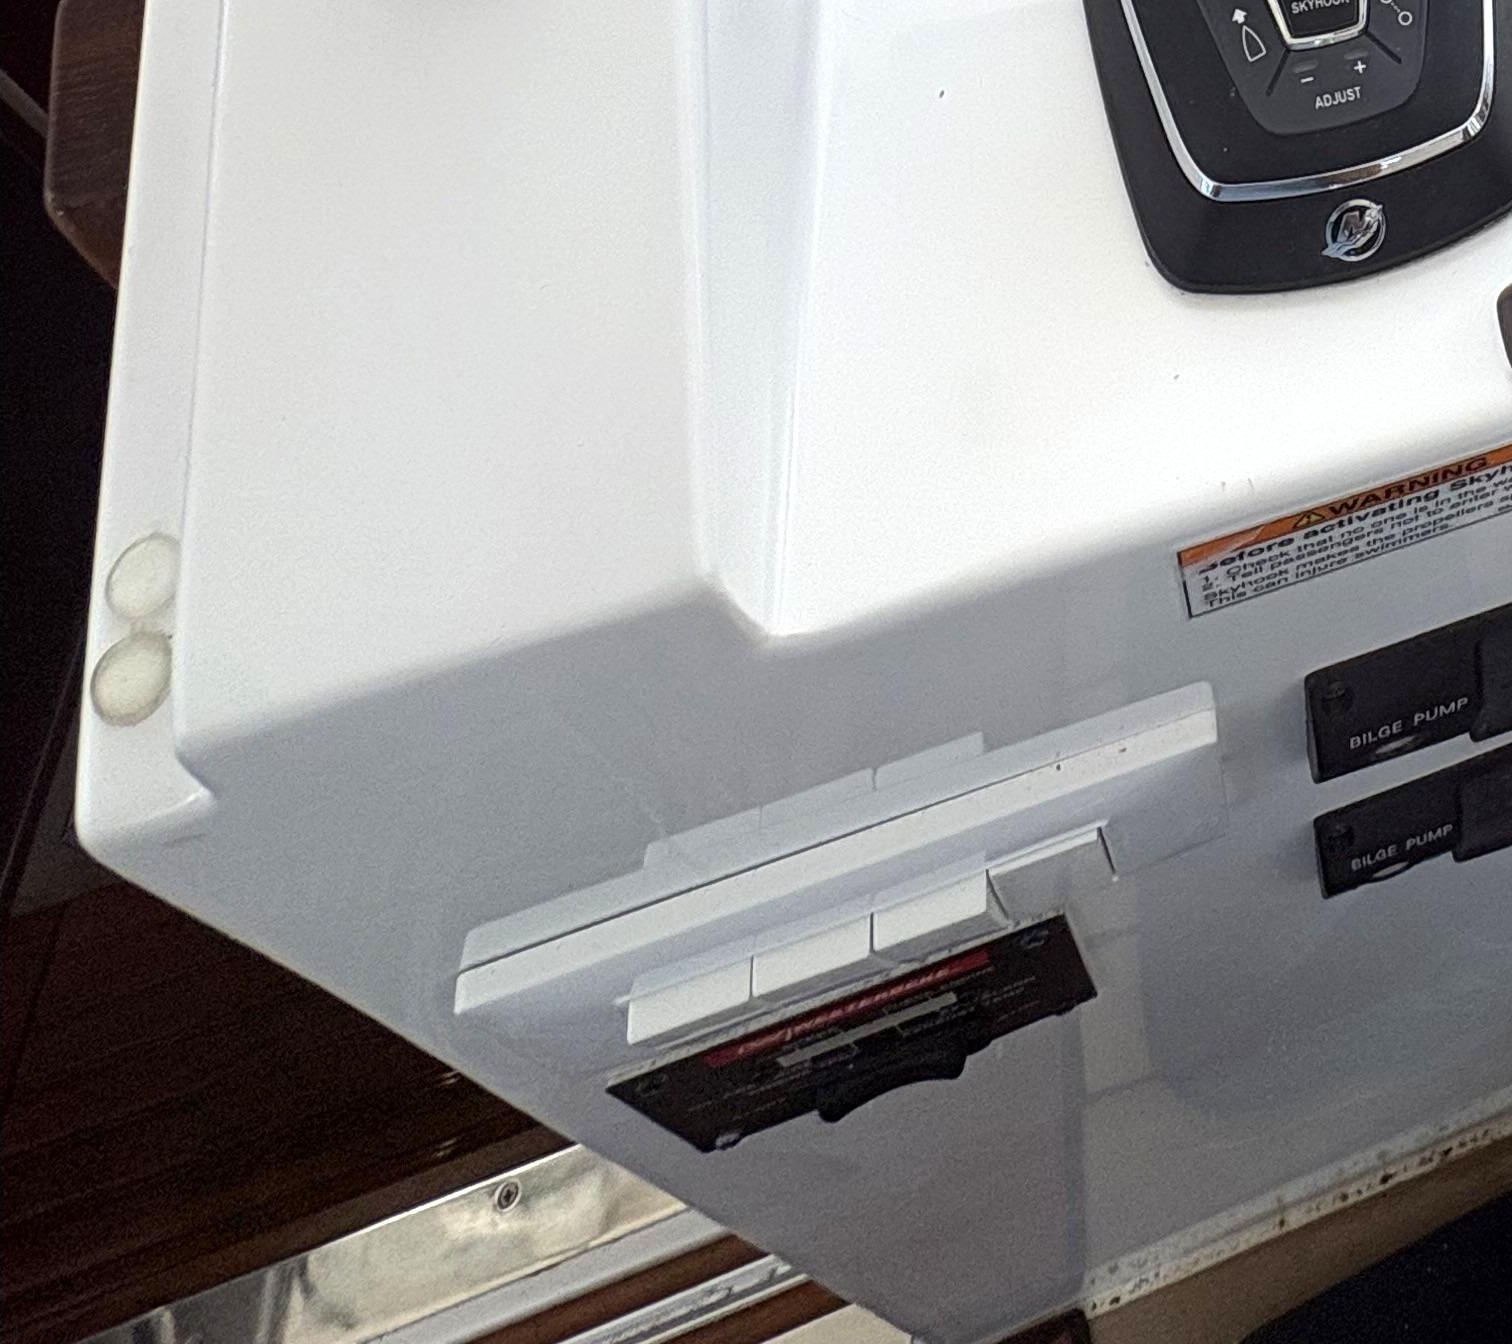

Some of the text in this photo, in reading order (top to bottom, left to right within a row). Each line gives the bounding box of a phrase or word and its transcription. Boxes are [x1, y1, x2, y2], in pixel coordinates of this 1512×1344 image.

[1314, 86, 1363, 110] ADJUST
[1329, 455, 1489, 513] WARNING
[1226, 551, 1289, 576] Check
[1297, 535, 1334, 554] that
[1340, 525, 1365, 539] no
[1370, 511, 1407, 529] one
[1434, 497, 1452, 510] in
[1456, 484, 1486, 502] the
[1231, 565, 1263, 582] Tell
[1270, 527, 1384, 572] passengers
[1390, 515, 1420, 532] not
[1449, 493, 1490, 512] enter
[1303, 488, 1441, 540] activating
[1203, 570, 1289, 601] Skyhook
[1295, 544, 1360, 570] makes
[1366, 532, 1396, 548] the
[1402, 499, 1494, 538] propellers
[1208, 588, 1249, 607] This
[1252, 577, 1289, 593] can
[1295, 556, 1347, 580] injure
[1349, 697, 1469, 750] BILGE PUMP
[1351, 824, 1454, 872] BILGE PUMP
